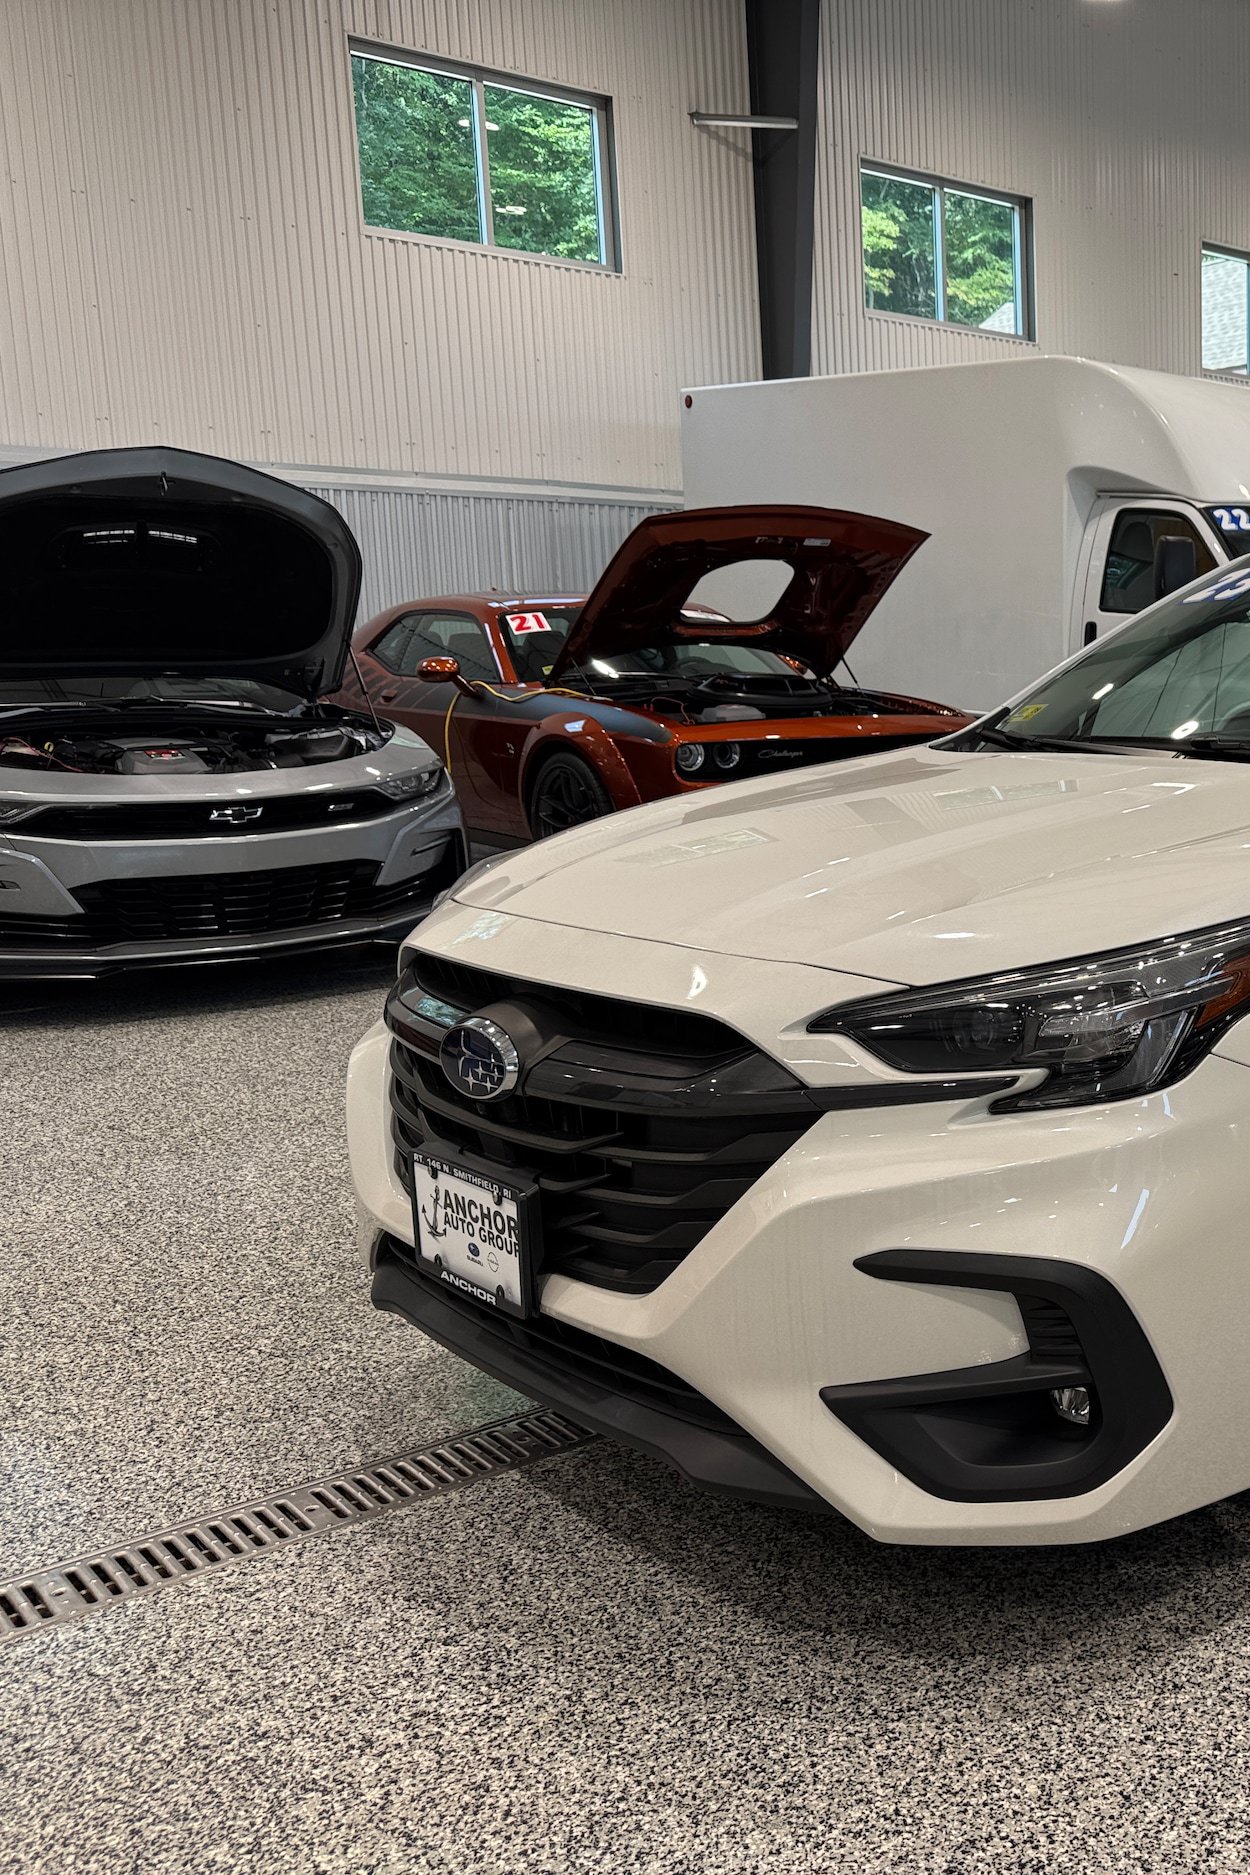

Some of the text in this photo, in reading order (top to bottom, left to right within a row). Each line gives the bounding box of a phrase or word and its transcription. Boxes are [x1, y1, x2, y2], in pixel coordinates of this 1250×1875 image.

[510, 614, 545, 632] 21
[427, 1158, 442, 1170] 146
[503, 1189, 512, 1199] RI
[444, 1189, 520, 1242] ANCHOR
[444, 1211, 475, 1238] AUTO
[440, 1270, 497, 1306] ANCHOR
